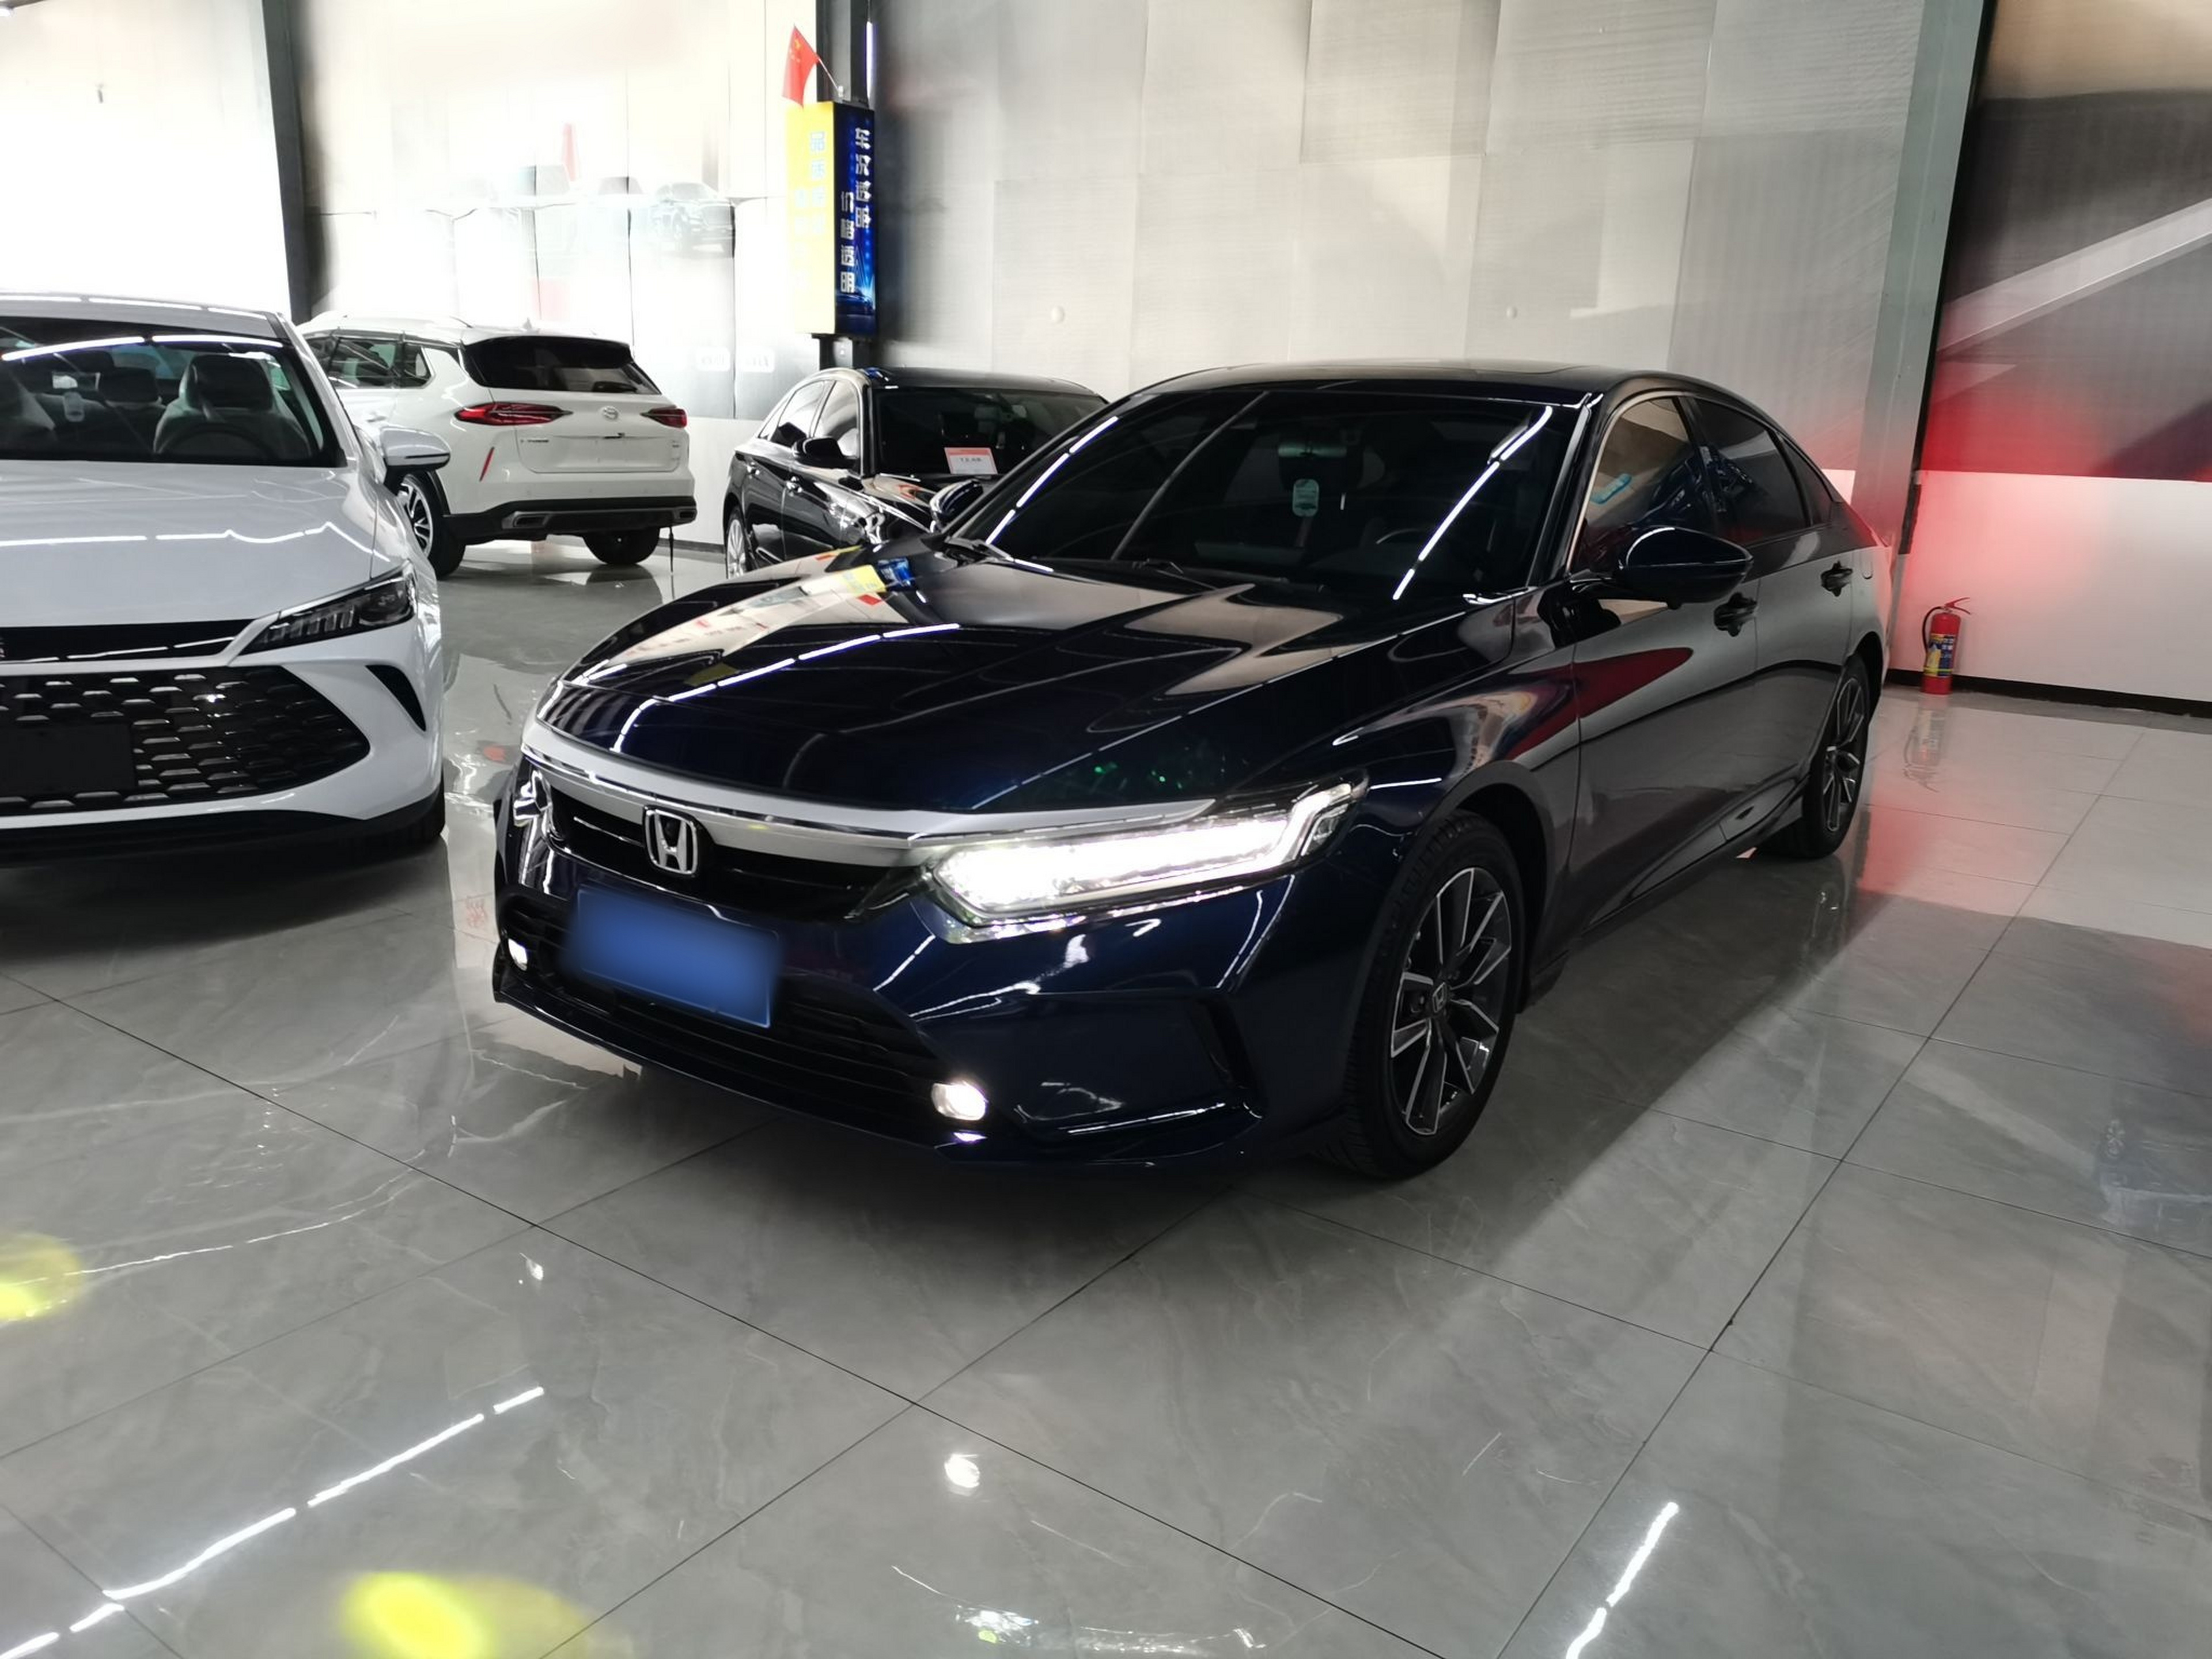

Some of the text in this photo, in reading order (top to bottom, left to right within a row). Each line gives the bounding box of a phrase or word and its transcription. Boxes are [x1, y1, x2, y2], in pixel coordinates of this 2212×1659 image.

[855, 127, 872, 229] 车况透明
[840, 191, 855, 293] 价格透明
